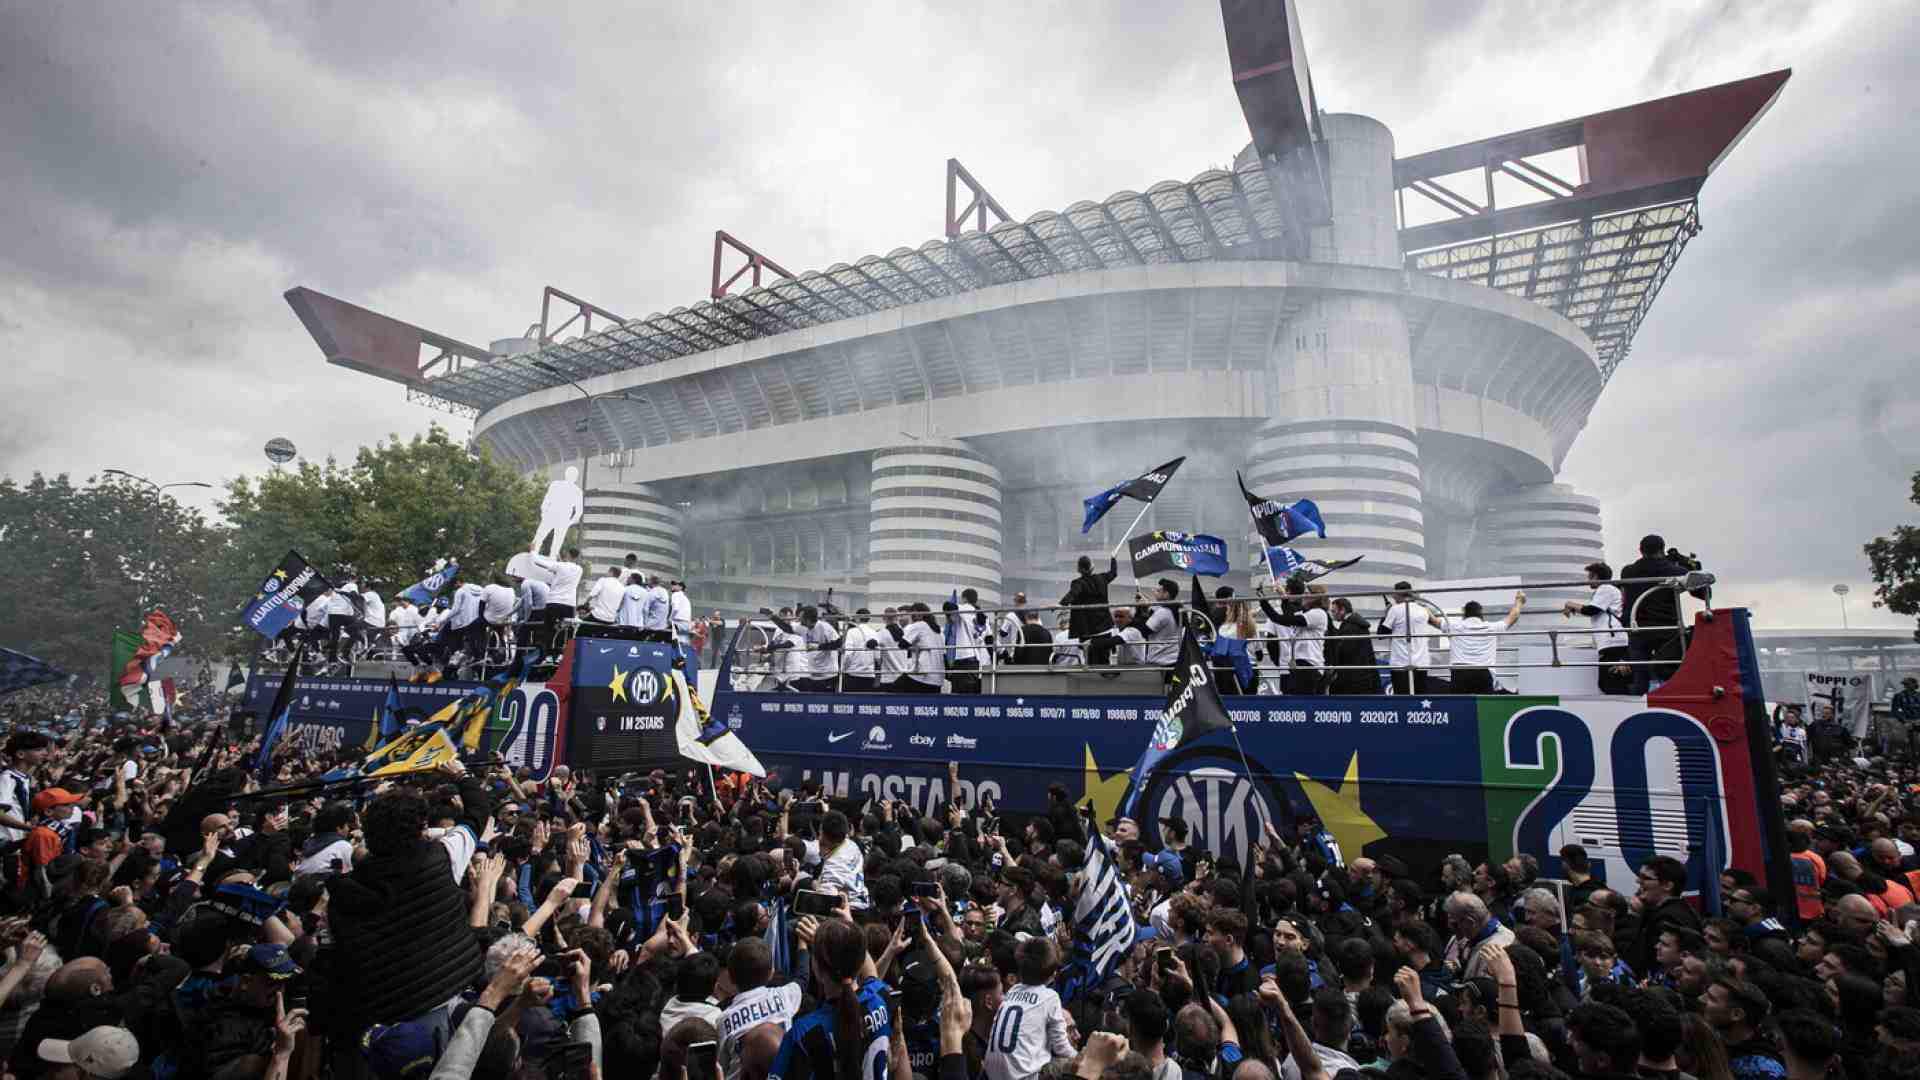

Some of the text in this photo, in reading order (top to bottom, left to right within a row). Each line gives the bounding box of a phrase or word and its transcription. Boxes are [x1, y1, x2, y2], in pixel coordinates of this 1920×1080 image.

[1808, 673, 1846, 686] POPPI
[634, 716, 664, 730] 2STARS
[1229, 710, 1260, 722] 007/08
[1268, 710, 1307, 723] 2008/09
[1314, 711, 1352, 723] 2009/10
[1360, 711, 1399, 724] 2020/21
[1406, 711, 1450, 725] 2023/24
[498, 688, 560, 784] 20
[910, 732, 936, 748] ebay
[1504, 705, 1732, 900] 20
[724, 996, 786, 1035] BARELLA
[991, 1005, 1023, 1054] 10
